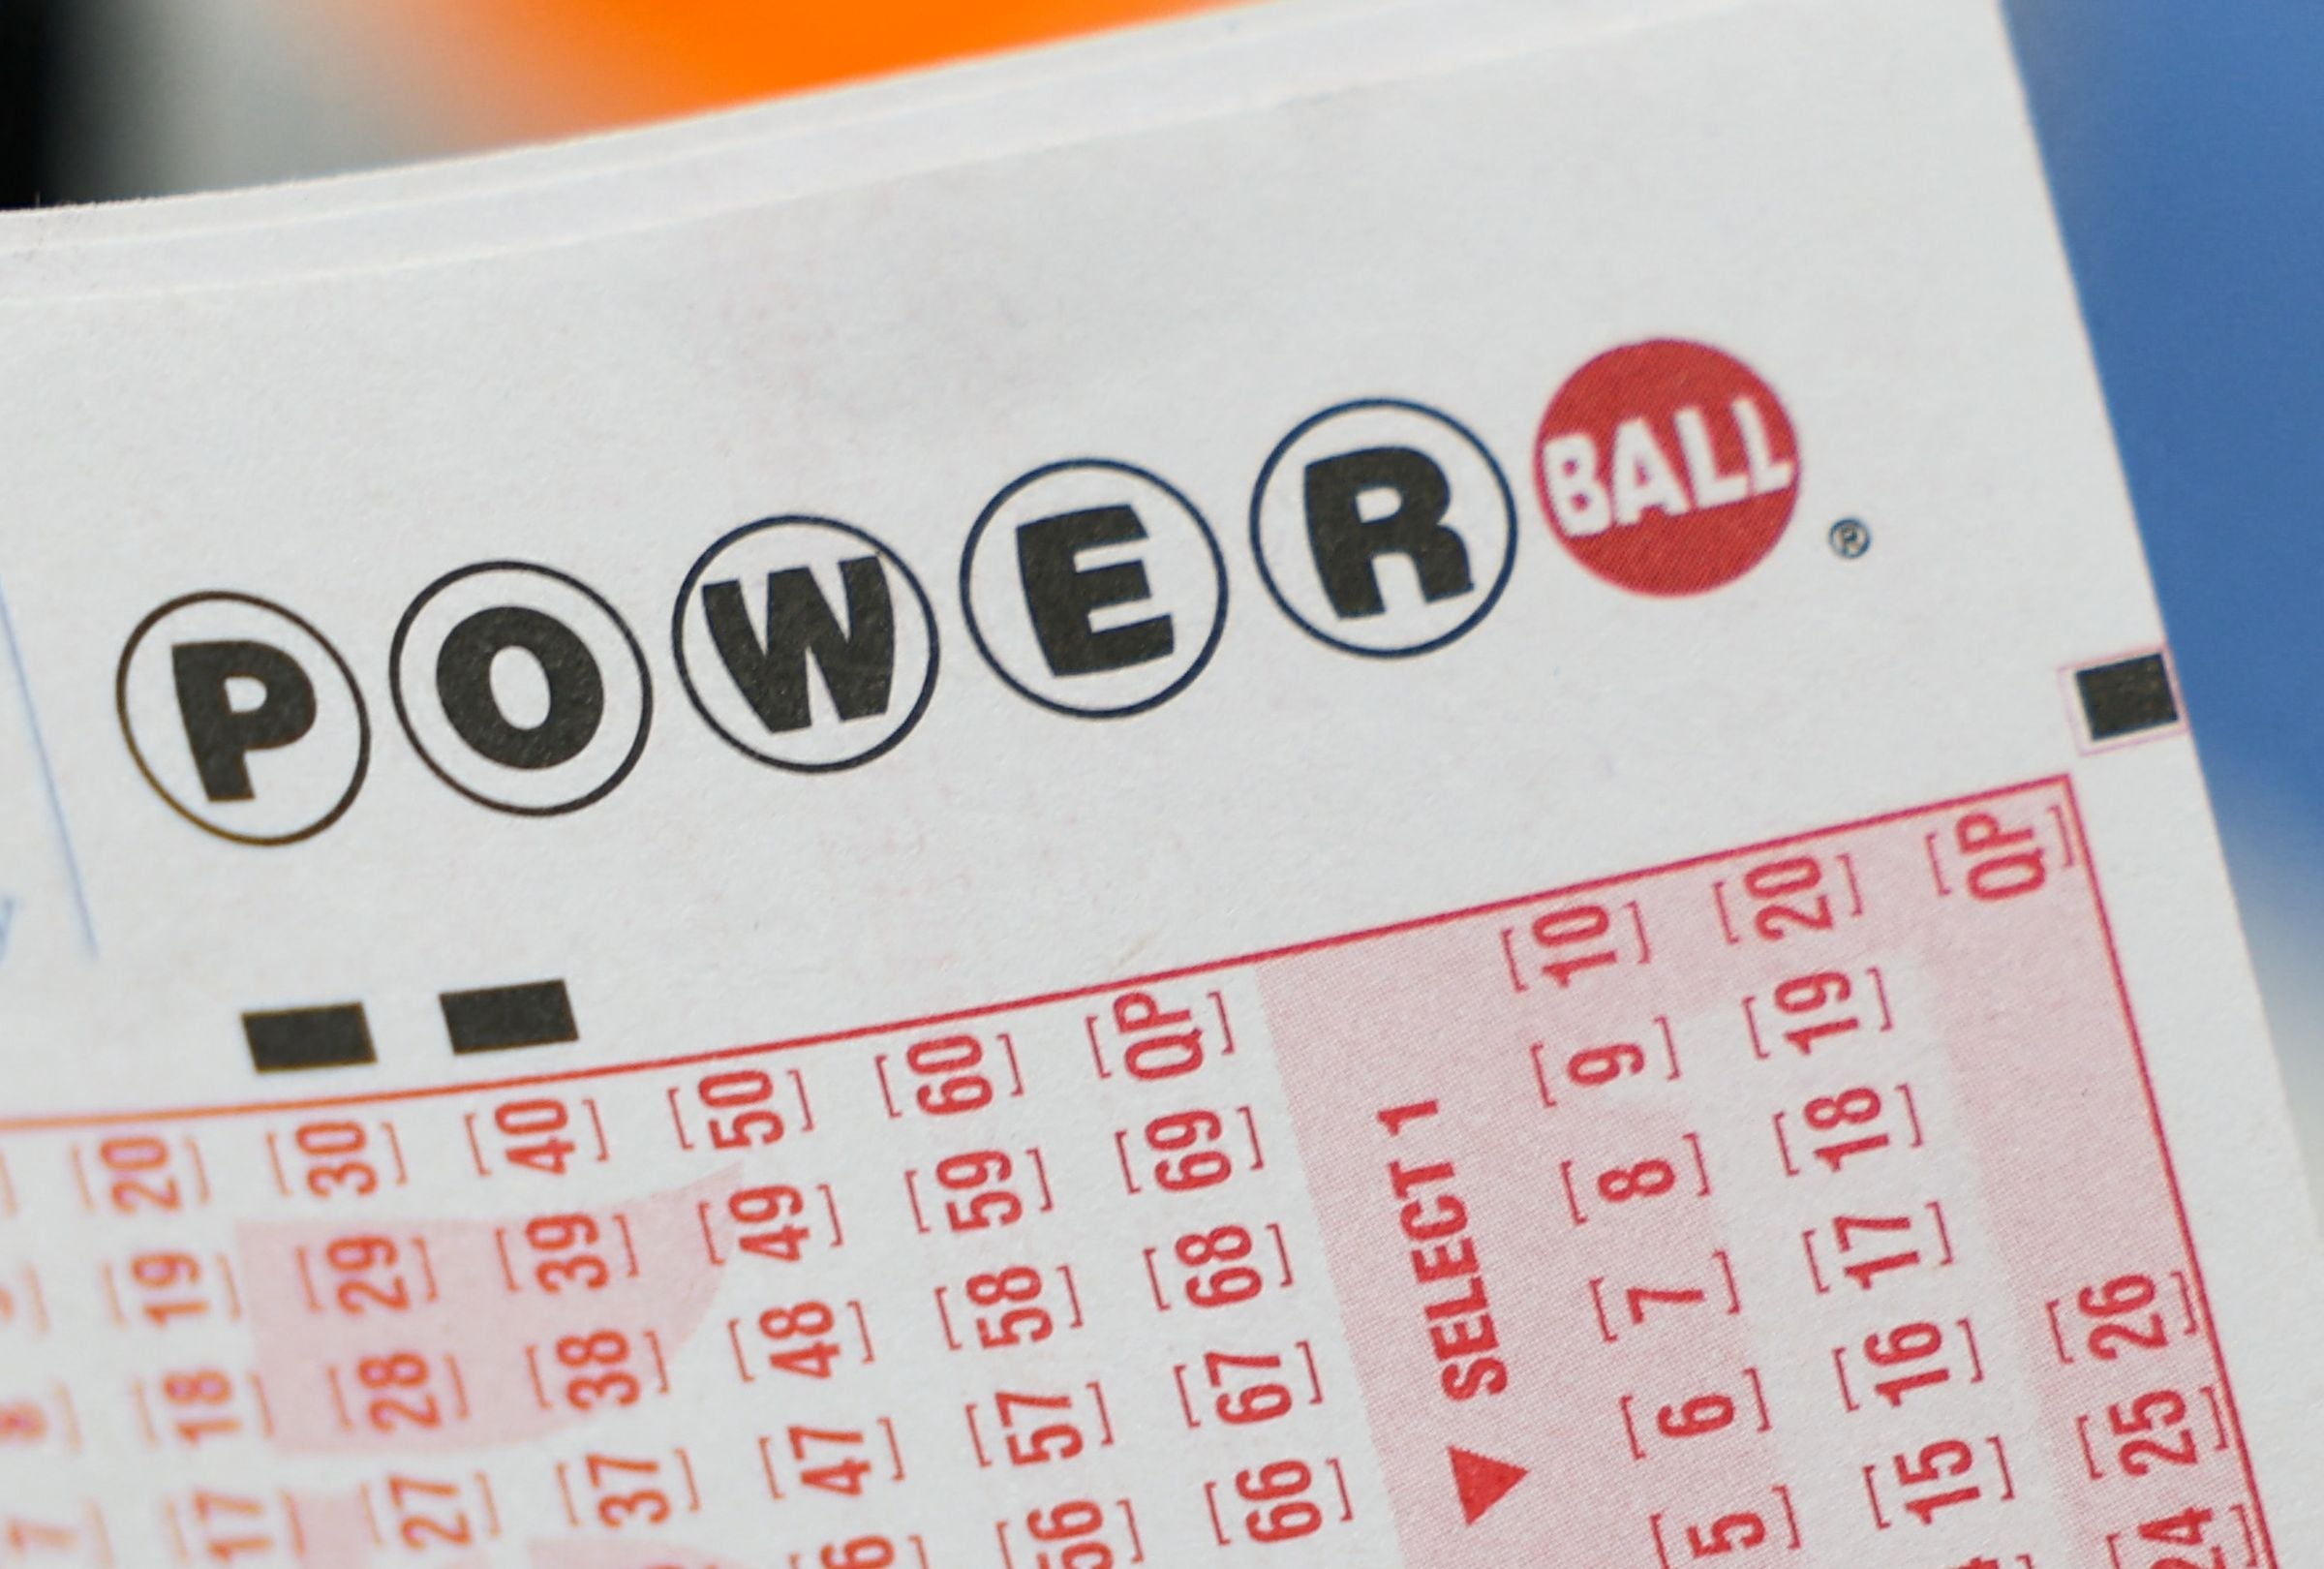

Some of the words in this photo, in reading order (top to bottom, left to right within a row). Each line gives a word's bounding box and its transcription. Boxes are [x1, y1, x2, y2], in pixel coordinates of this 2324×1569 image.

[171, 445, 1475, 803] POWER
[1545, 397, 1792, 538] BALL
[1954, 811, 2049, 904] QP
[1742, 855, 1834, 942] 20
[1531, 903, 1619, 989] 10
[1113, 991, 1205, 1082] QP
[1774, 969, 1860, 1055] 19
[905, 1033, 994, 1117] 60
[1565, 1042, 1646, 1088] 9
[494, 1098, 575, 1176] 40
[697, 1068, 785, 1151] 50
[1376, 1098, 1439, 1137] 1
[1803, 1087, 1890, 1171] 18
[99, 1136, 181, 1214] 20
[294, 1120, 379, 1198] 30
[935, 1149, 1024, 1233] 59
[1145, 1109, 1233, 1193] 69
[1596, 1157, 1677, 1205] 8
[524, 1213, 610, 1294] 39
[727, 1184, 810, 1262] 49
[1832, 1212, 1920, 1291] 17
[131, 1251, 207, 1328] 19
[324, 1234, 411, 1315] 29
[1175, 1224, 1263, 1308] 68
[1388, 1161, 1510, 1401] SELECT
[1625, 1286, 1706, 1325] 7
[758, 1300, 841, 1380] 48
[965, 1265, 1053, 1350] 58
[2075, 1273, 2169, 1362] 26
[356, 1351, 443, 1433] 28
[555, 1328, 641, 1412] 38
[1205, 1350, 1292, 1426] 67
[1863, 1321, 1950, 1407] 16
[163, 1369, 239, 1445] 18
[994, 1392, 1084, 1467] 57
[1656, 1393, 1737, 1440] 6
[2106, 1388, 2200, 1478] 25
[586, 1453, 671, 1528] 37
[788, 1426, 871, 1496] 47
[1235, 1459, 1323, 1544] 66
[1894, 1438, 1981, 1525] 15
[194, 1491, 273, 1562] 17
[389, 1475, 472, 1549] 27
[819, 1534, 896, 1569] 6
[1686, 1510, 1768, 1559] 5
